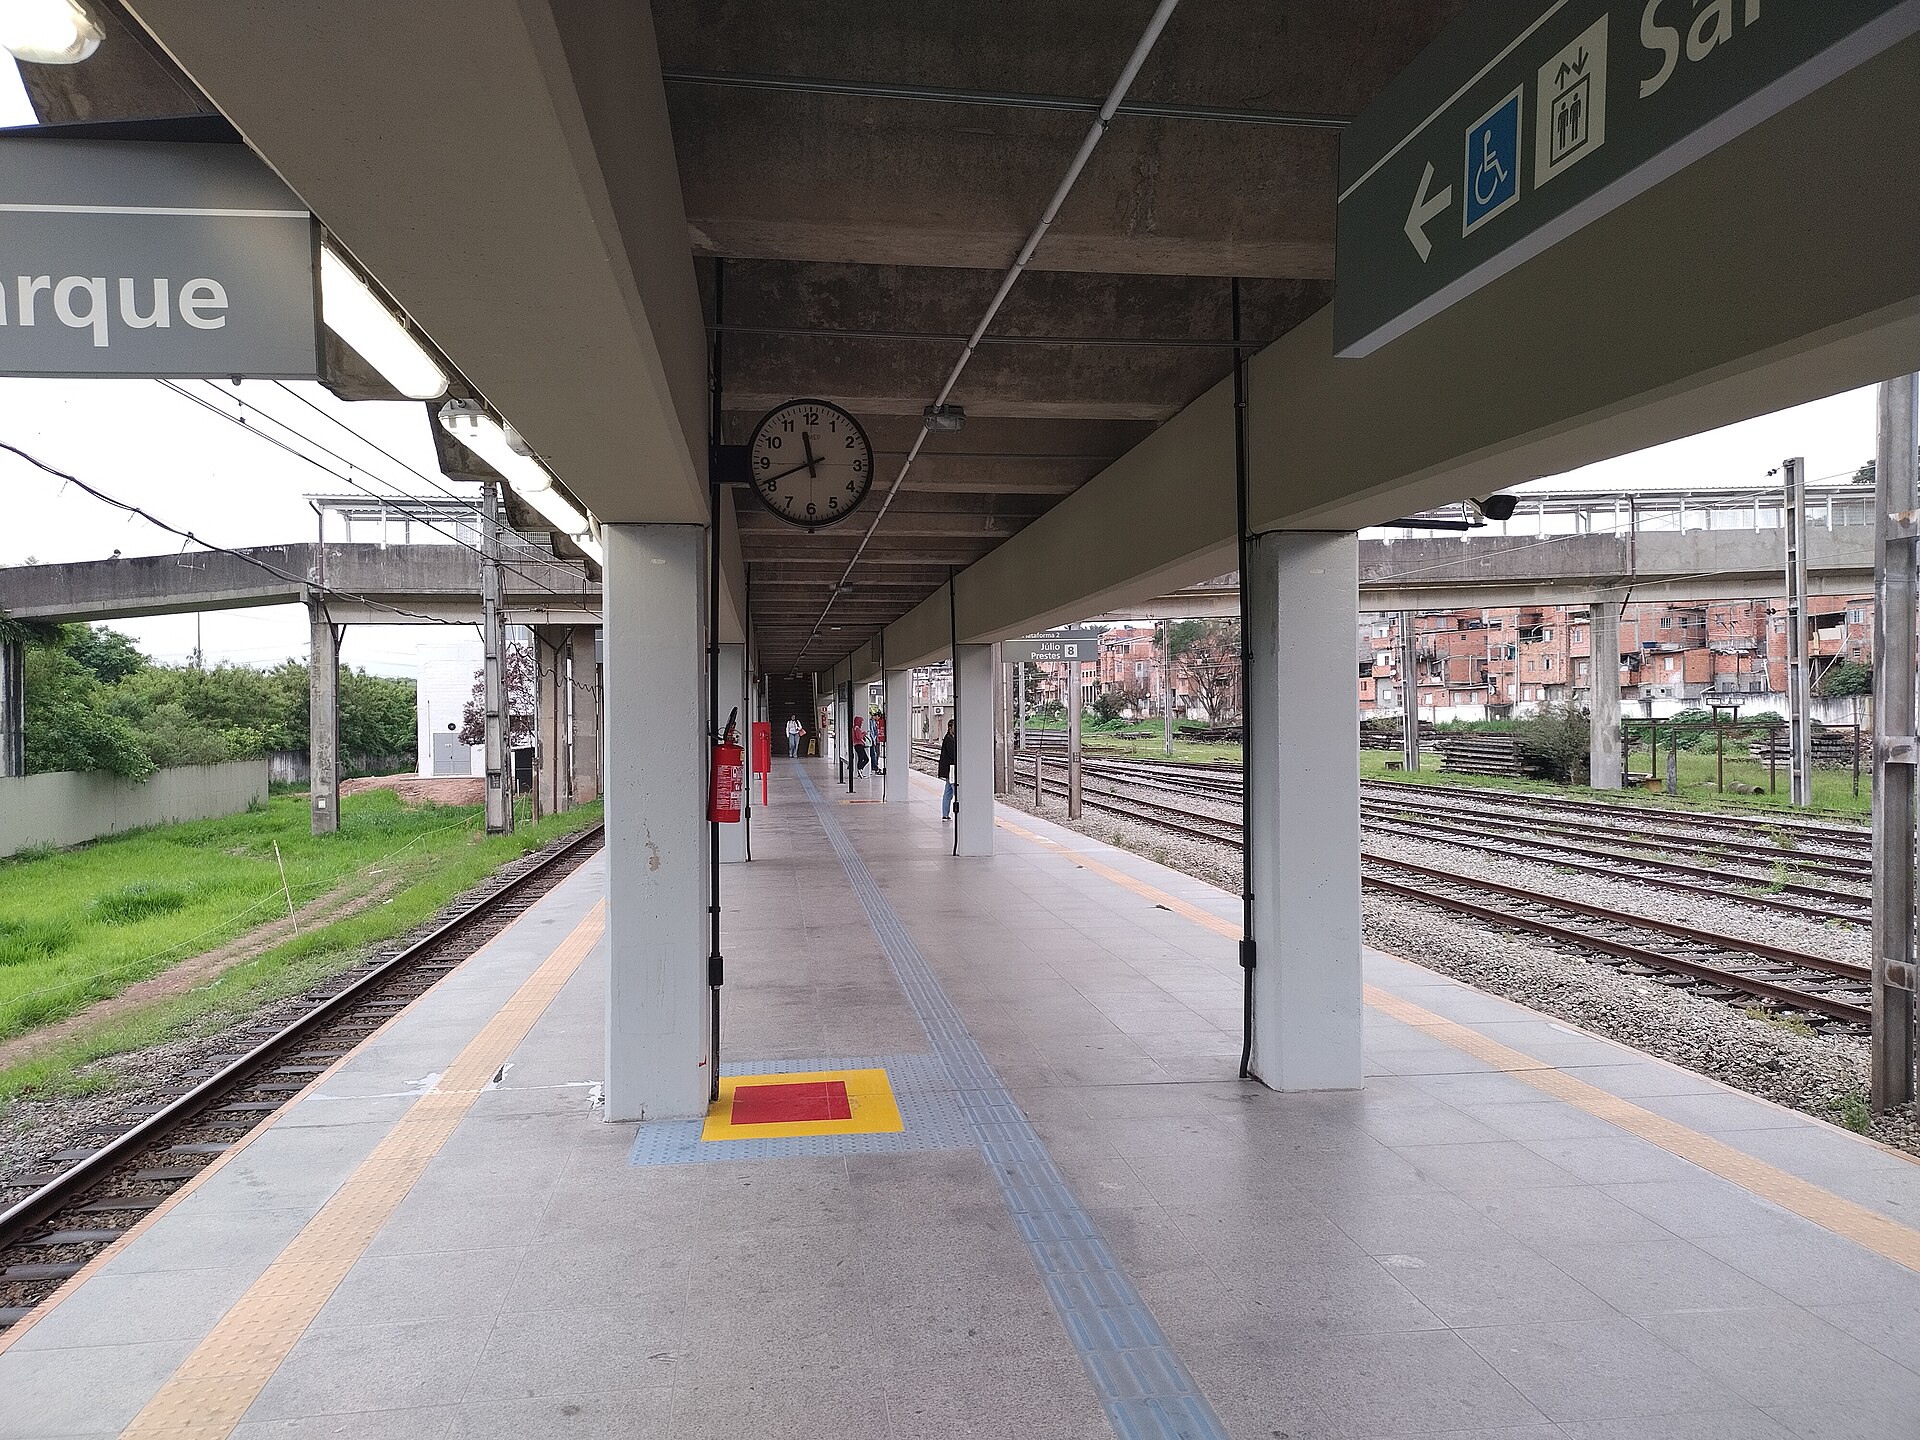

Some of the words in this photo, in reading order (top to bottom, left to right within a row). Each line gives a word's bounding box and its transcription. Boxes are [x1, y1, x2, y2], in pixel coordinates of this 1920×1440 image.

[1639, 0, 1761, 99] Sa
[0, 275, 229, 347] rque
[803, 413, 819, 425] 12
[781, 420, 794, 432] 11
[829, 420, 836, 432] 1
[765, 436, 782, 449] 10
[845, 436, 855, 449] 2
[760, 457, 770, 469] 9
[852, 459, 863, 472] 3
[767, 480, 777, 492] 8
[845, 480, 855, 492] 4
[784, 496, 794, 508] 7
[828, 497, 838, 509] 5
[805, 503, 817, 515] 6
[1040, 643, 1060, 651] Júlio
[1067, 646, 1075, 655] 8
[1031, 652, 1061, 660] Prestes
